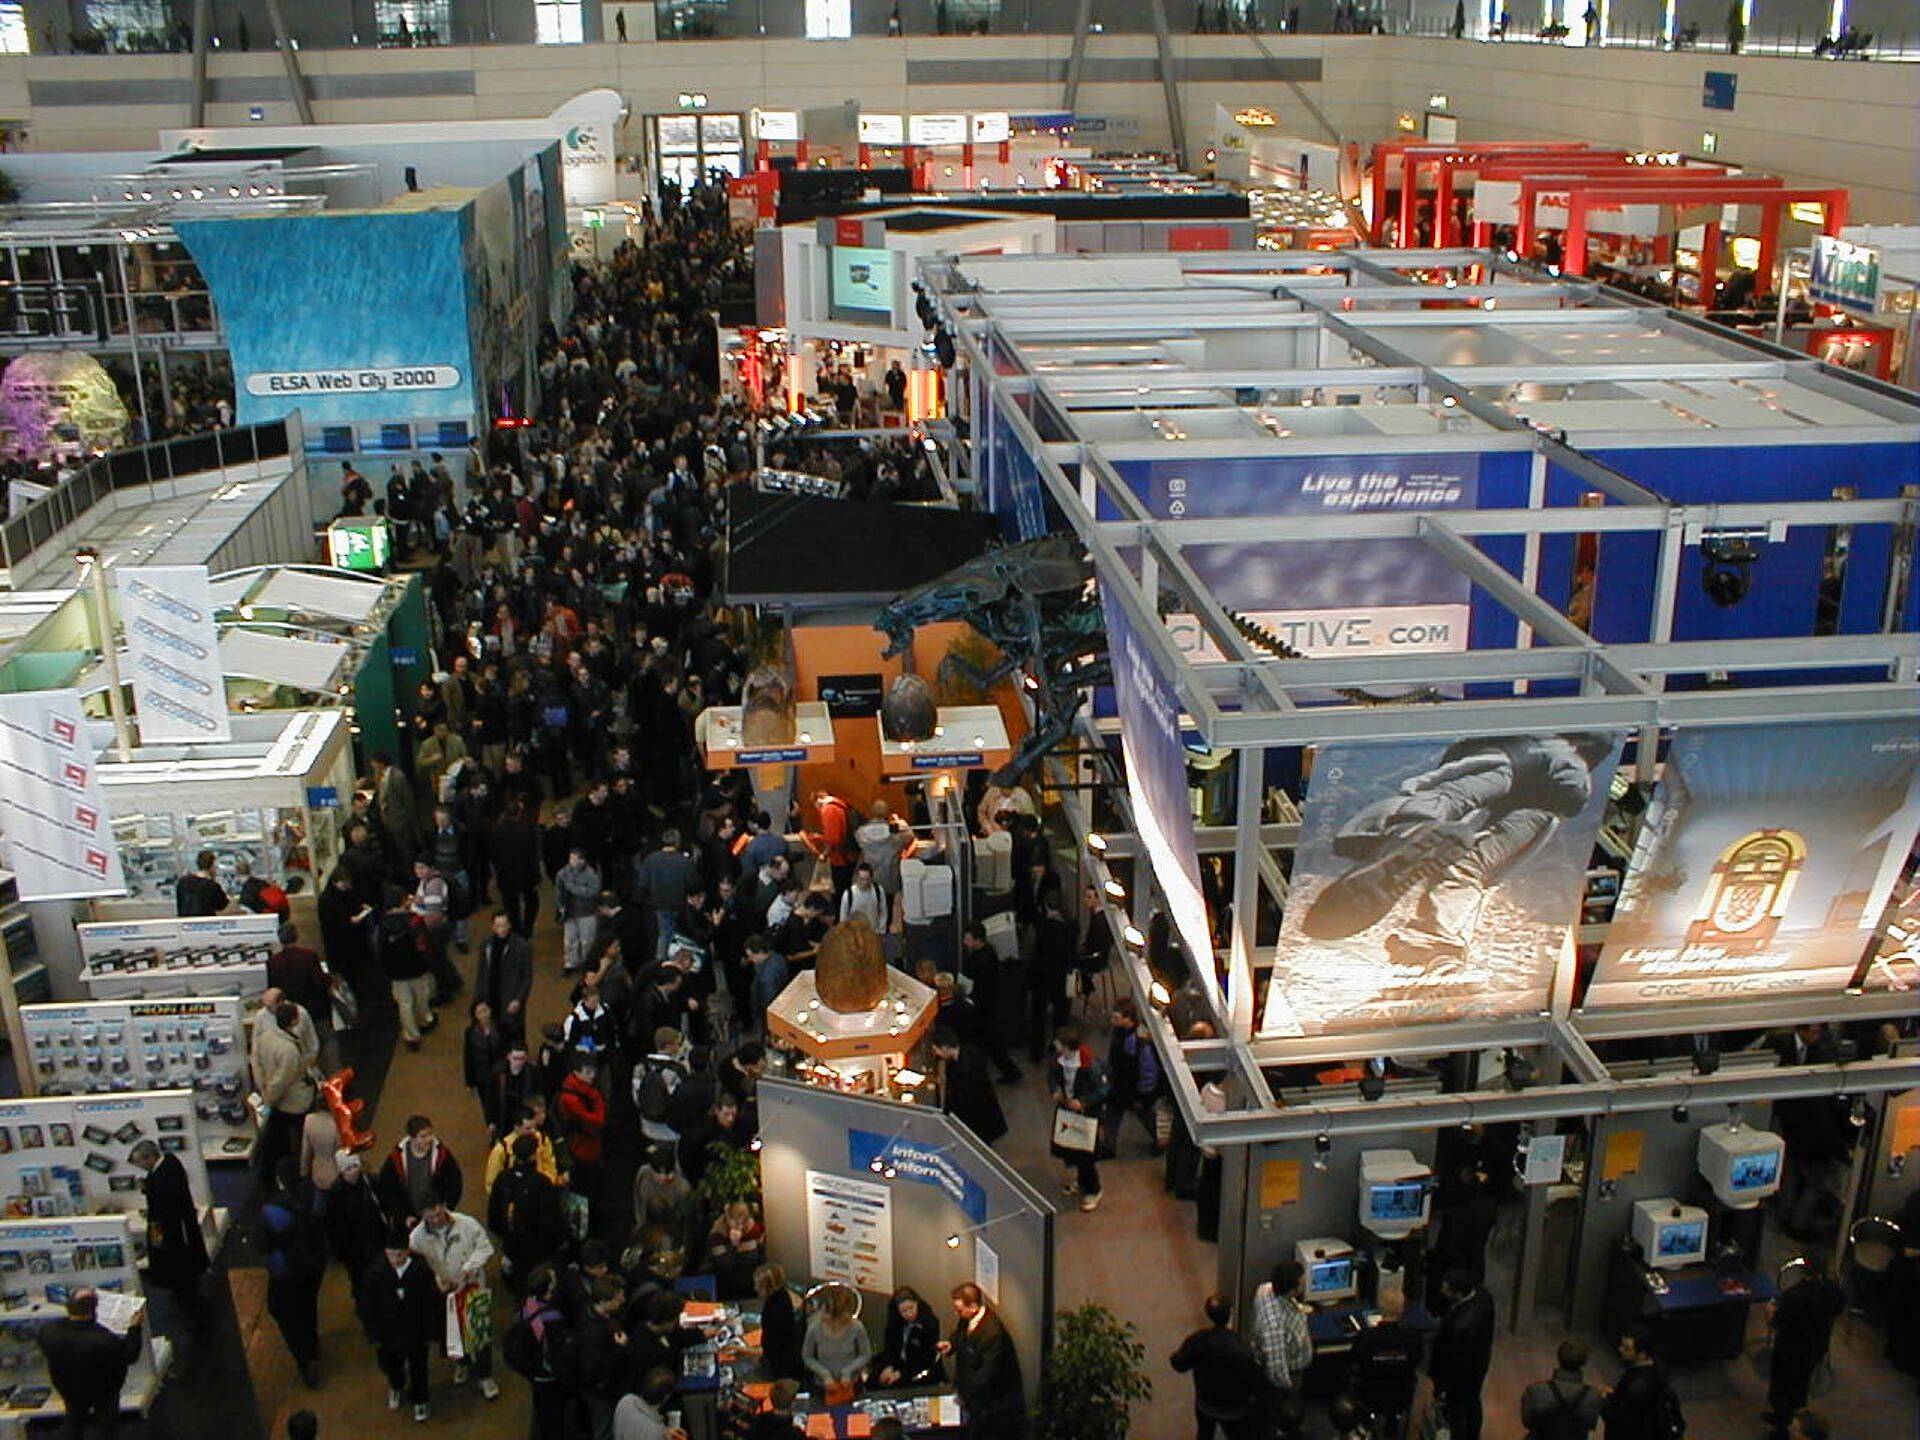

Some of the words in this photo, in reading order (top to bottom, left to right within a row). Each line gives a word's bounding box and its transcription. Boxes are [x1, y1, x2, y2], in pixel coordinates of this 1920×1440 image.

[270, 376, 311, 391] ELSA
[316, 374, 352, 389] Web
[359, 372, 387, 389] City
[393, 370, 436, 386] 2000
[1301, 474, 1352, 493] Live
[1359, 471, 1398, 490] the
[1322, 486, 1461, 509] experience
